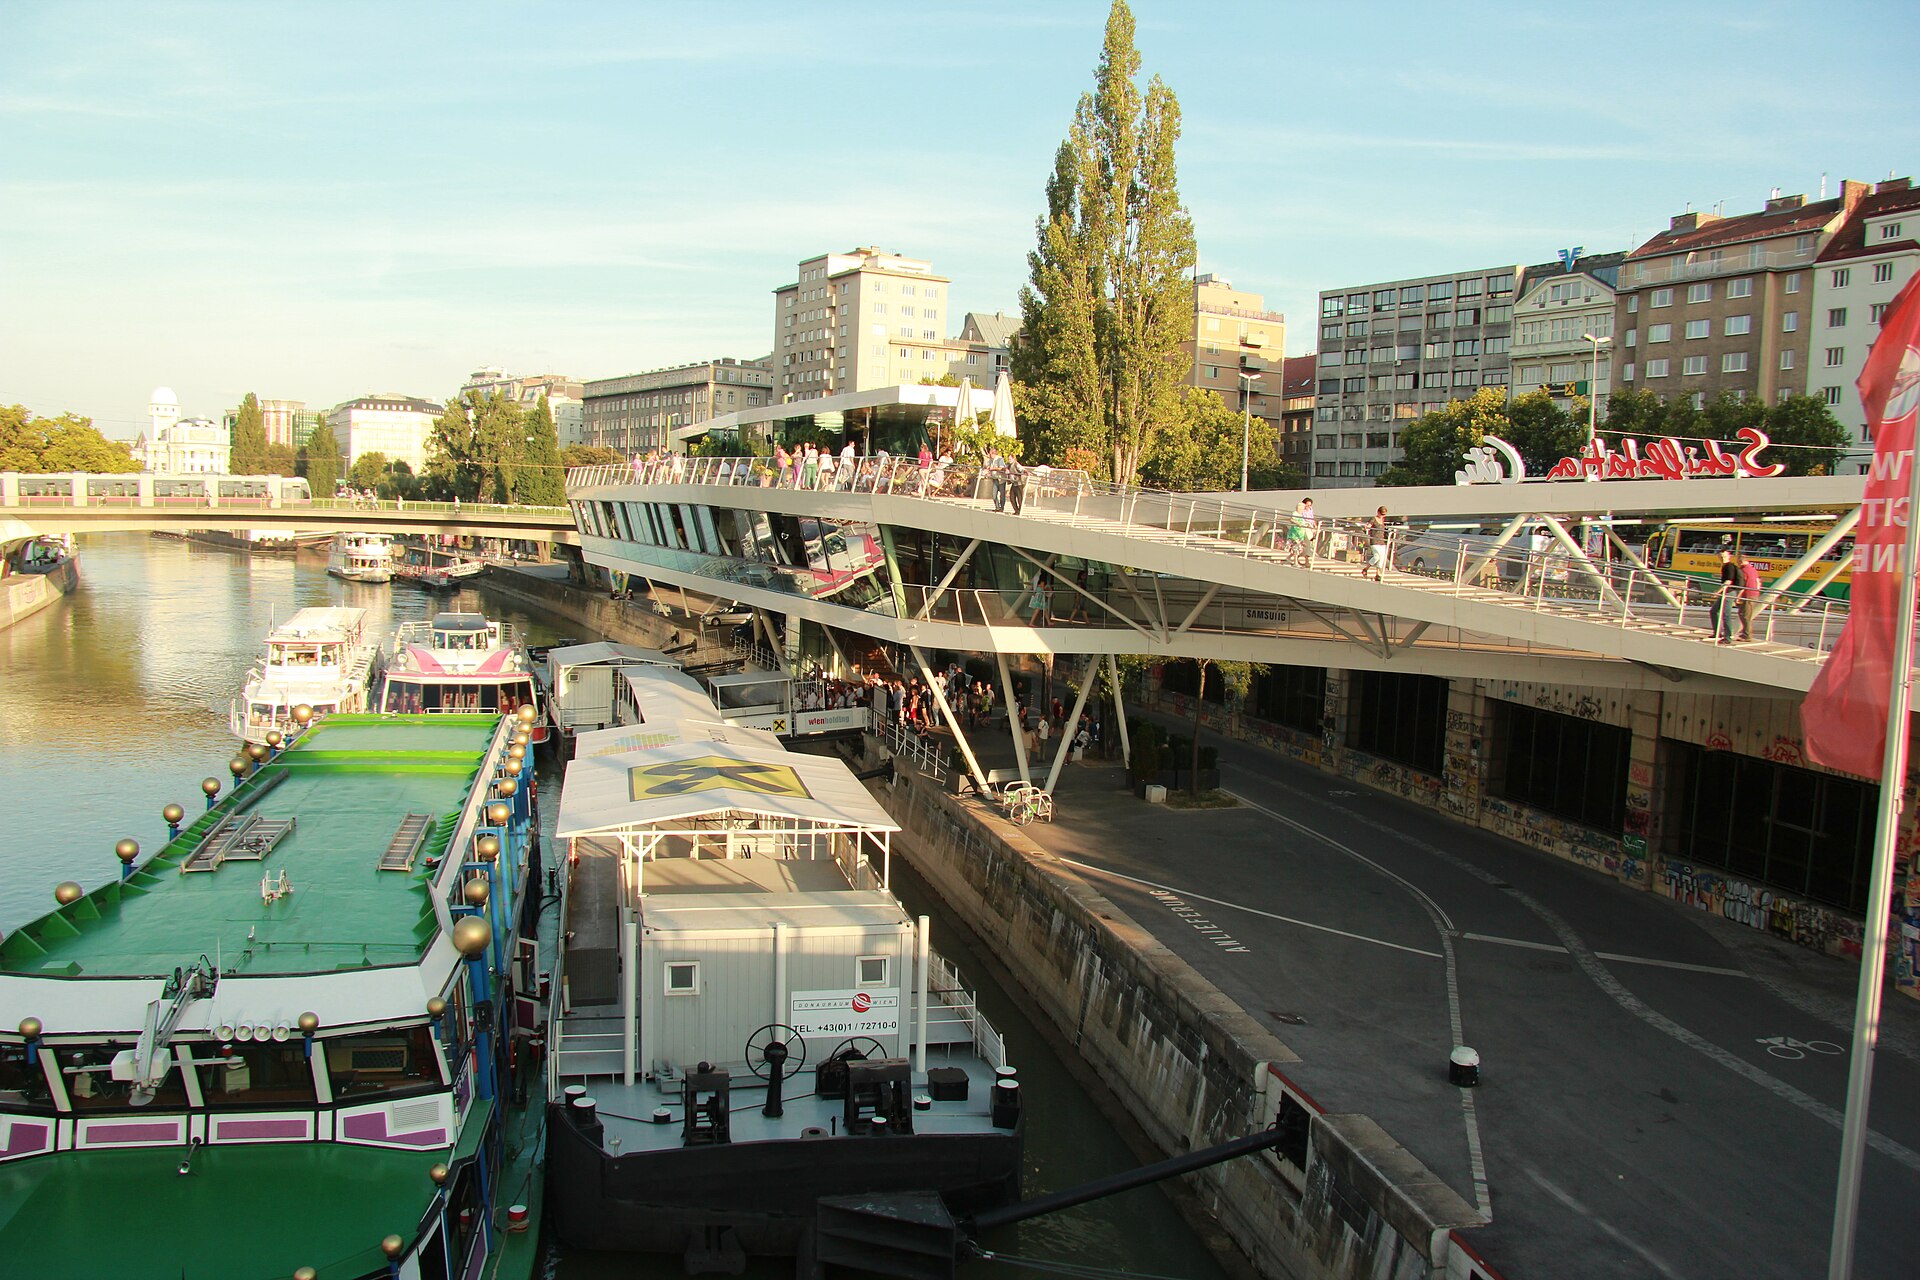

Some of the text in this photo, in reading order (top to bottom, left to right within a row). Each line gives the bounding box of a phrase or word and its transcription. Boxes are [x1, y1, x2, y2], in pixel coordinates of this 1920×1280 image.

[1246, 609, 1286, 622] SAMSUNG
[1149, 890, 1251, 953] ANLIEFERUNG
[793, 1024, 815, 1033] TEL.
[817, 1023, 852, 1032] +43(0)1
[860, 1021, 897, 1030] 72710-0
